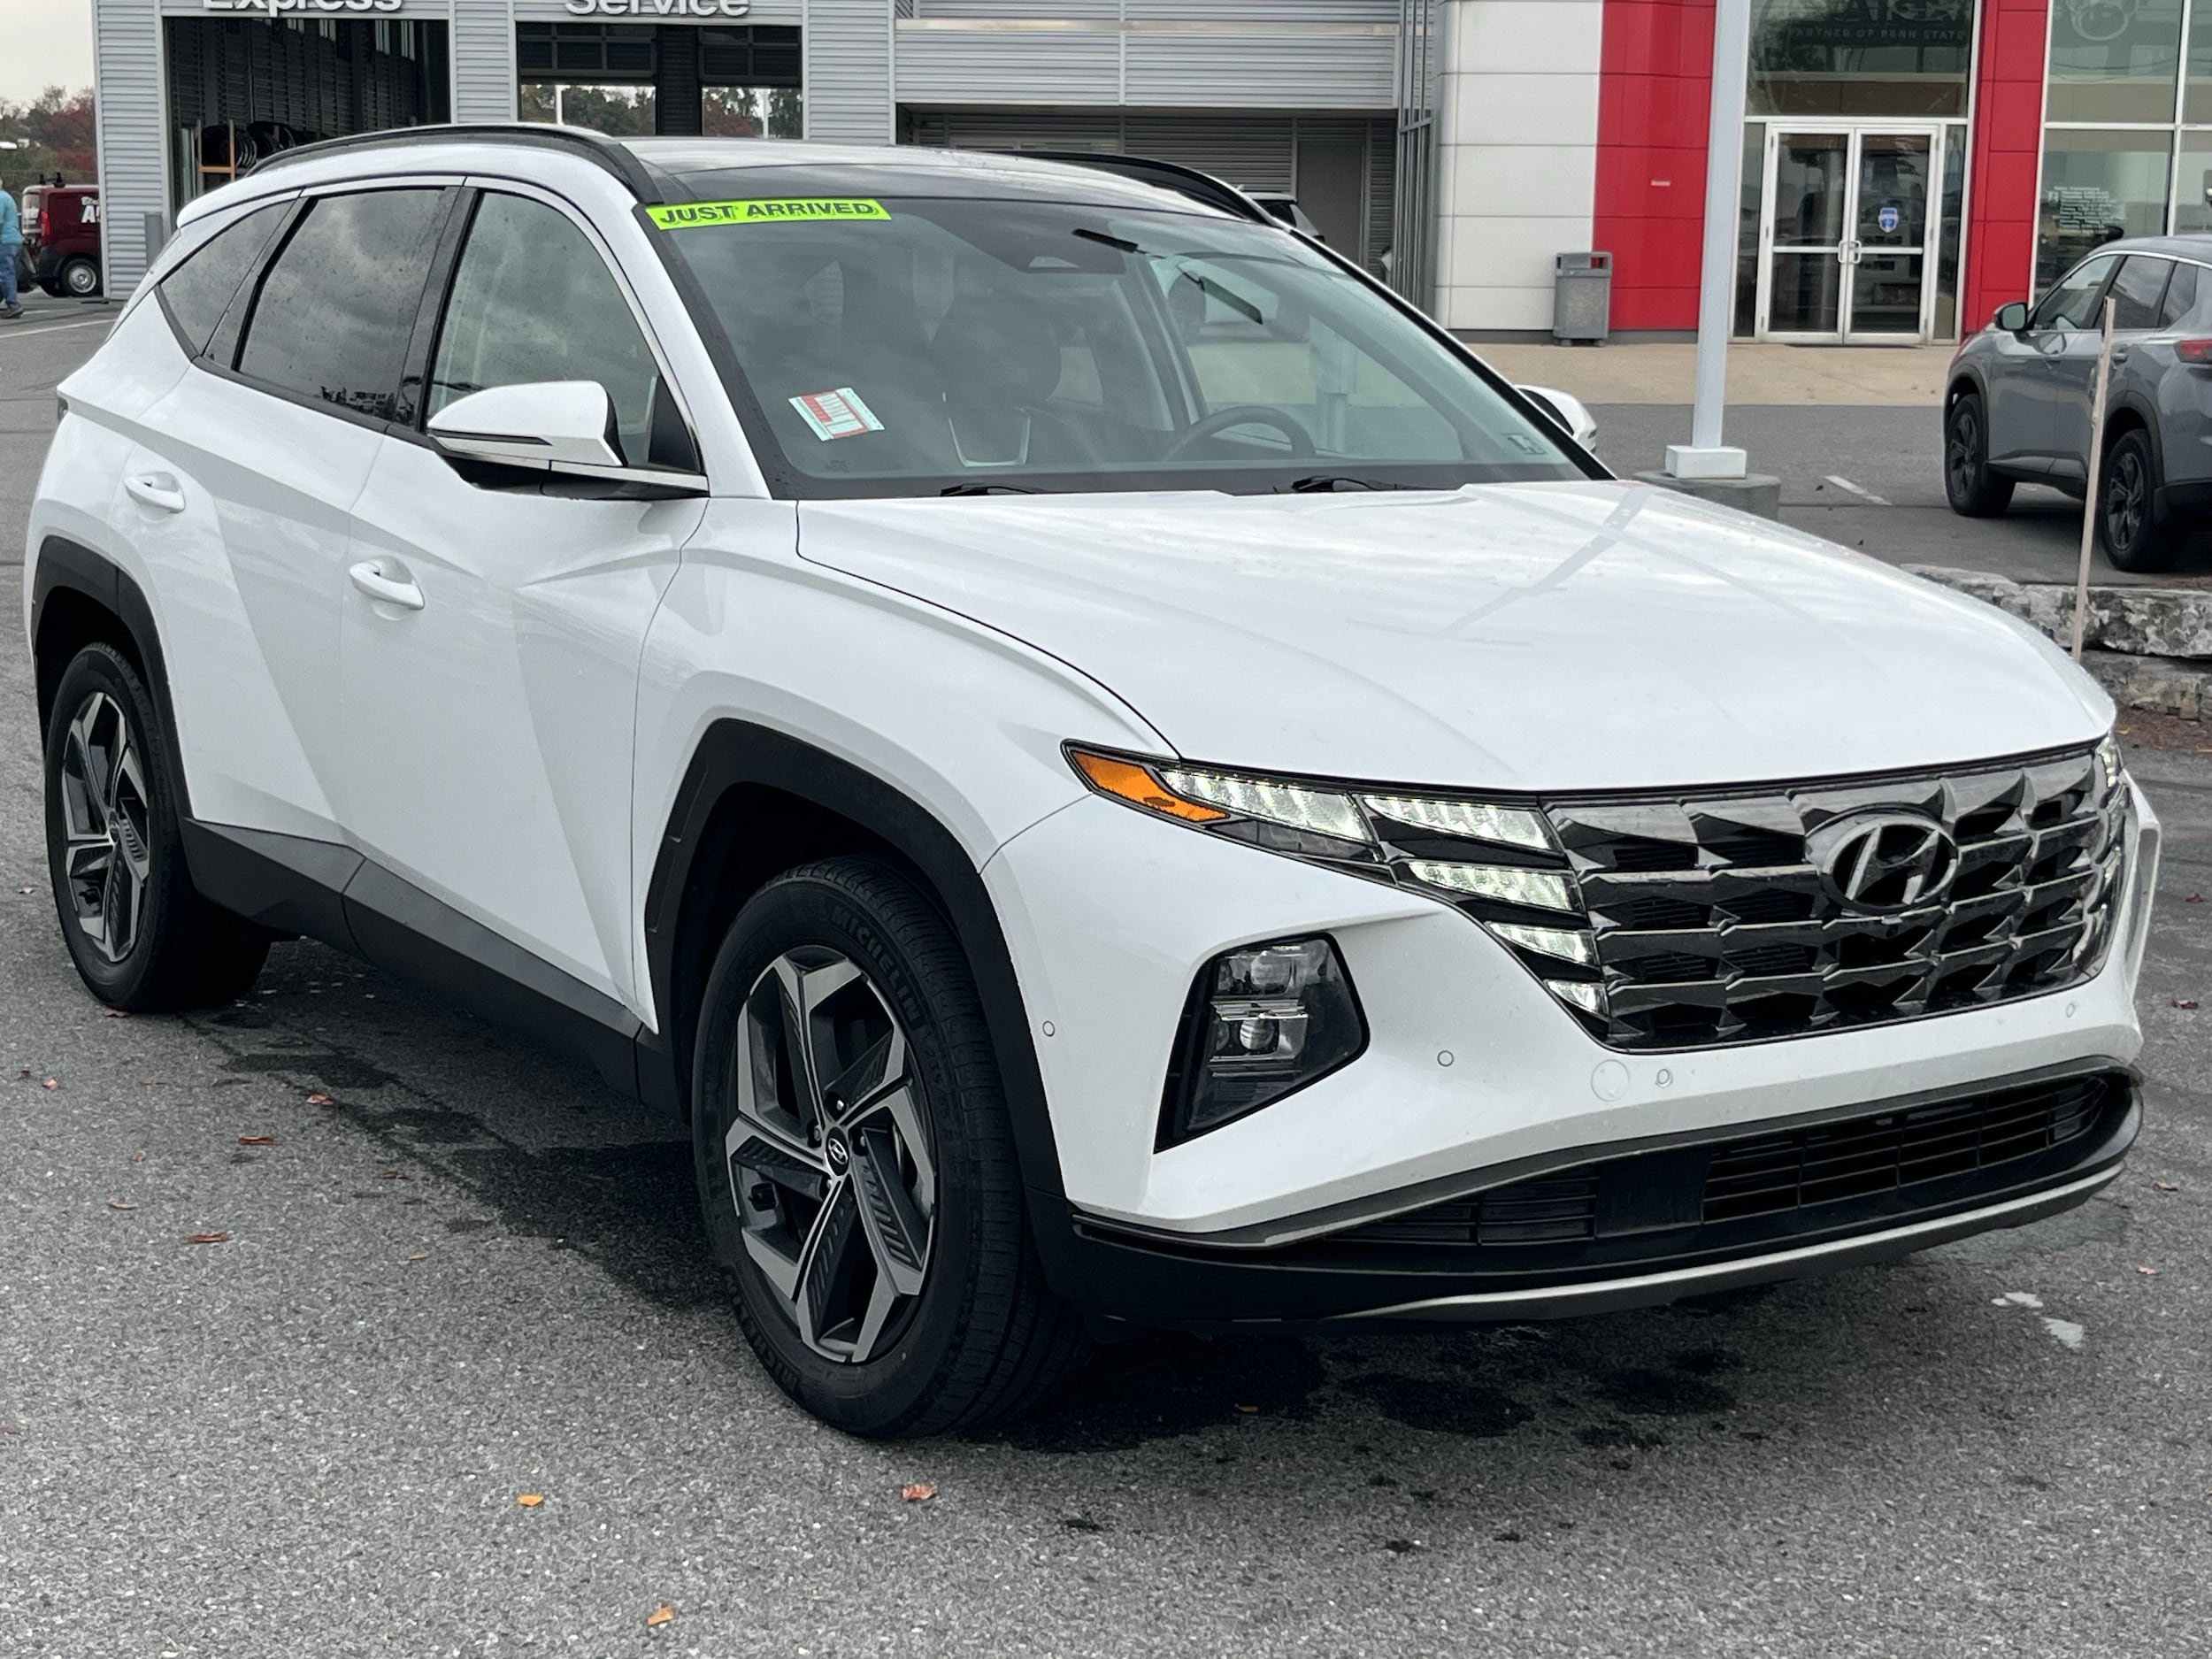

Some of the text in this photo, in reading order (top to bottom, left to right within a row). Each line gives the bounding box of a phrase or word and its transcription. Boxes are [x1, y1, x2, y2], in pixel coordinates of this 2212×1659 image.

[565, 0, 750, 17] Service
[1856, 29, 1875, 39] OF
[1881, 29, 1917, 40] PENN
[660, 202, 878, 224] JUST ARRIVED
[830, 904, 922, 1024] MICHELIN
